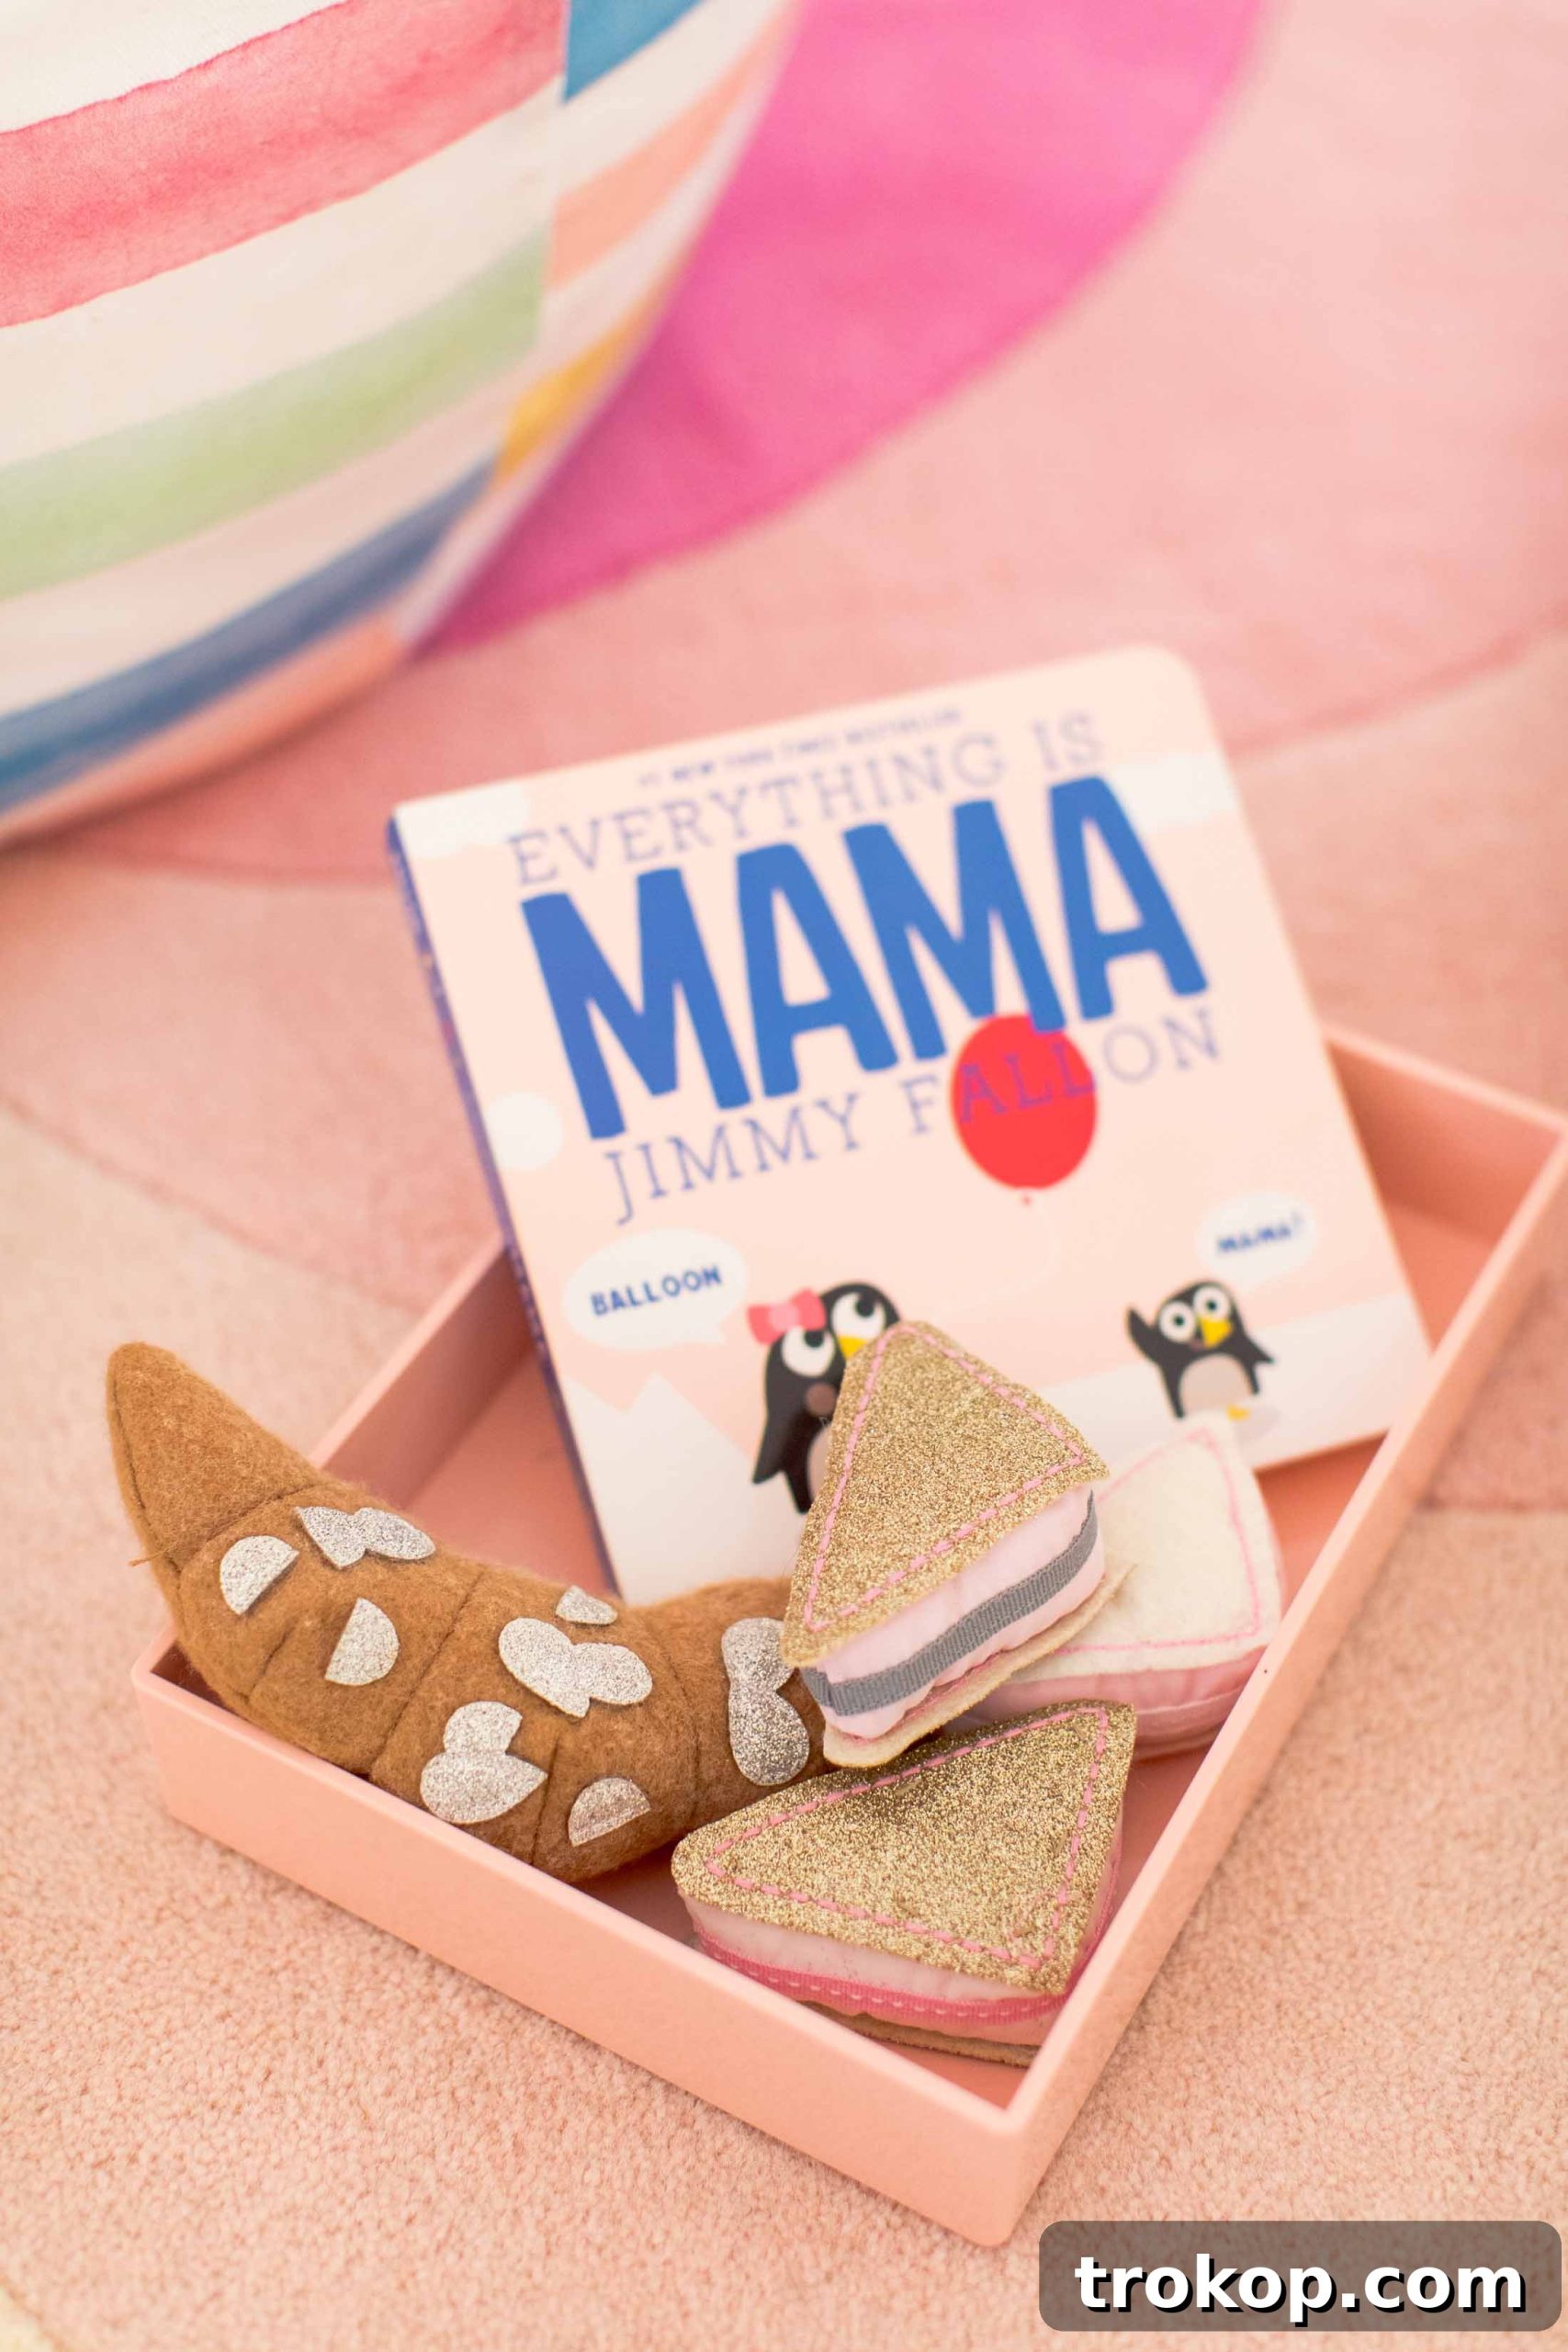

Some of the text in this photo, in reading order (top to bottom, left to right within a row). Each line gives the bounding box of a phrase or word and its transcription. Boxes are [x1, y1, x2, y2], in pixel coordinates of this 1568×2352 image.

[508, 732, 1008, 888] EVERYTHING
[1032, 711, 1104, 775] IS
[520, 775, 1209, 1141] MAMA
[604, 1007, 1220, 1225] JIMMY FALLON
[591, 1264, 722, 1316] BALLOON
